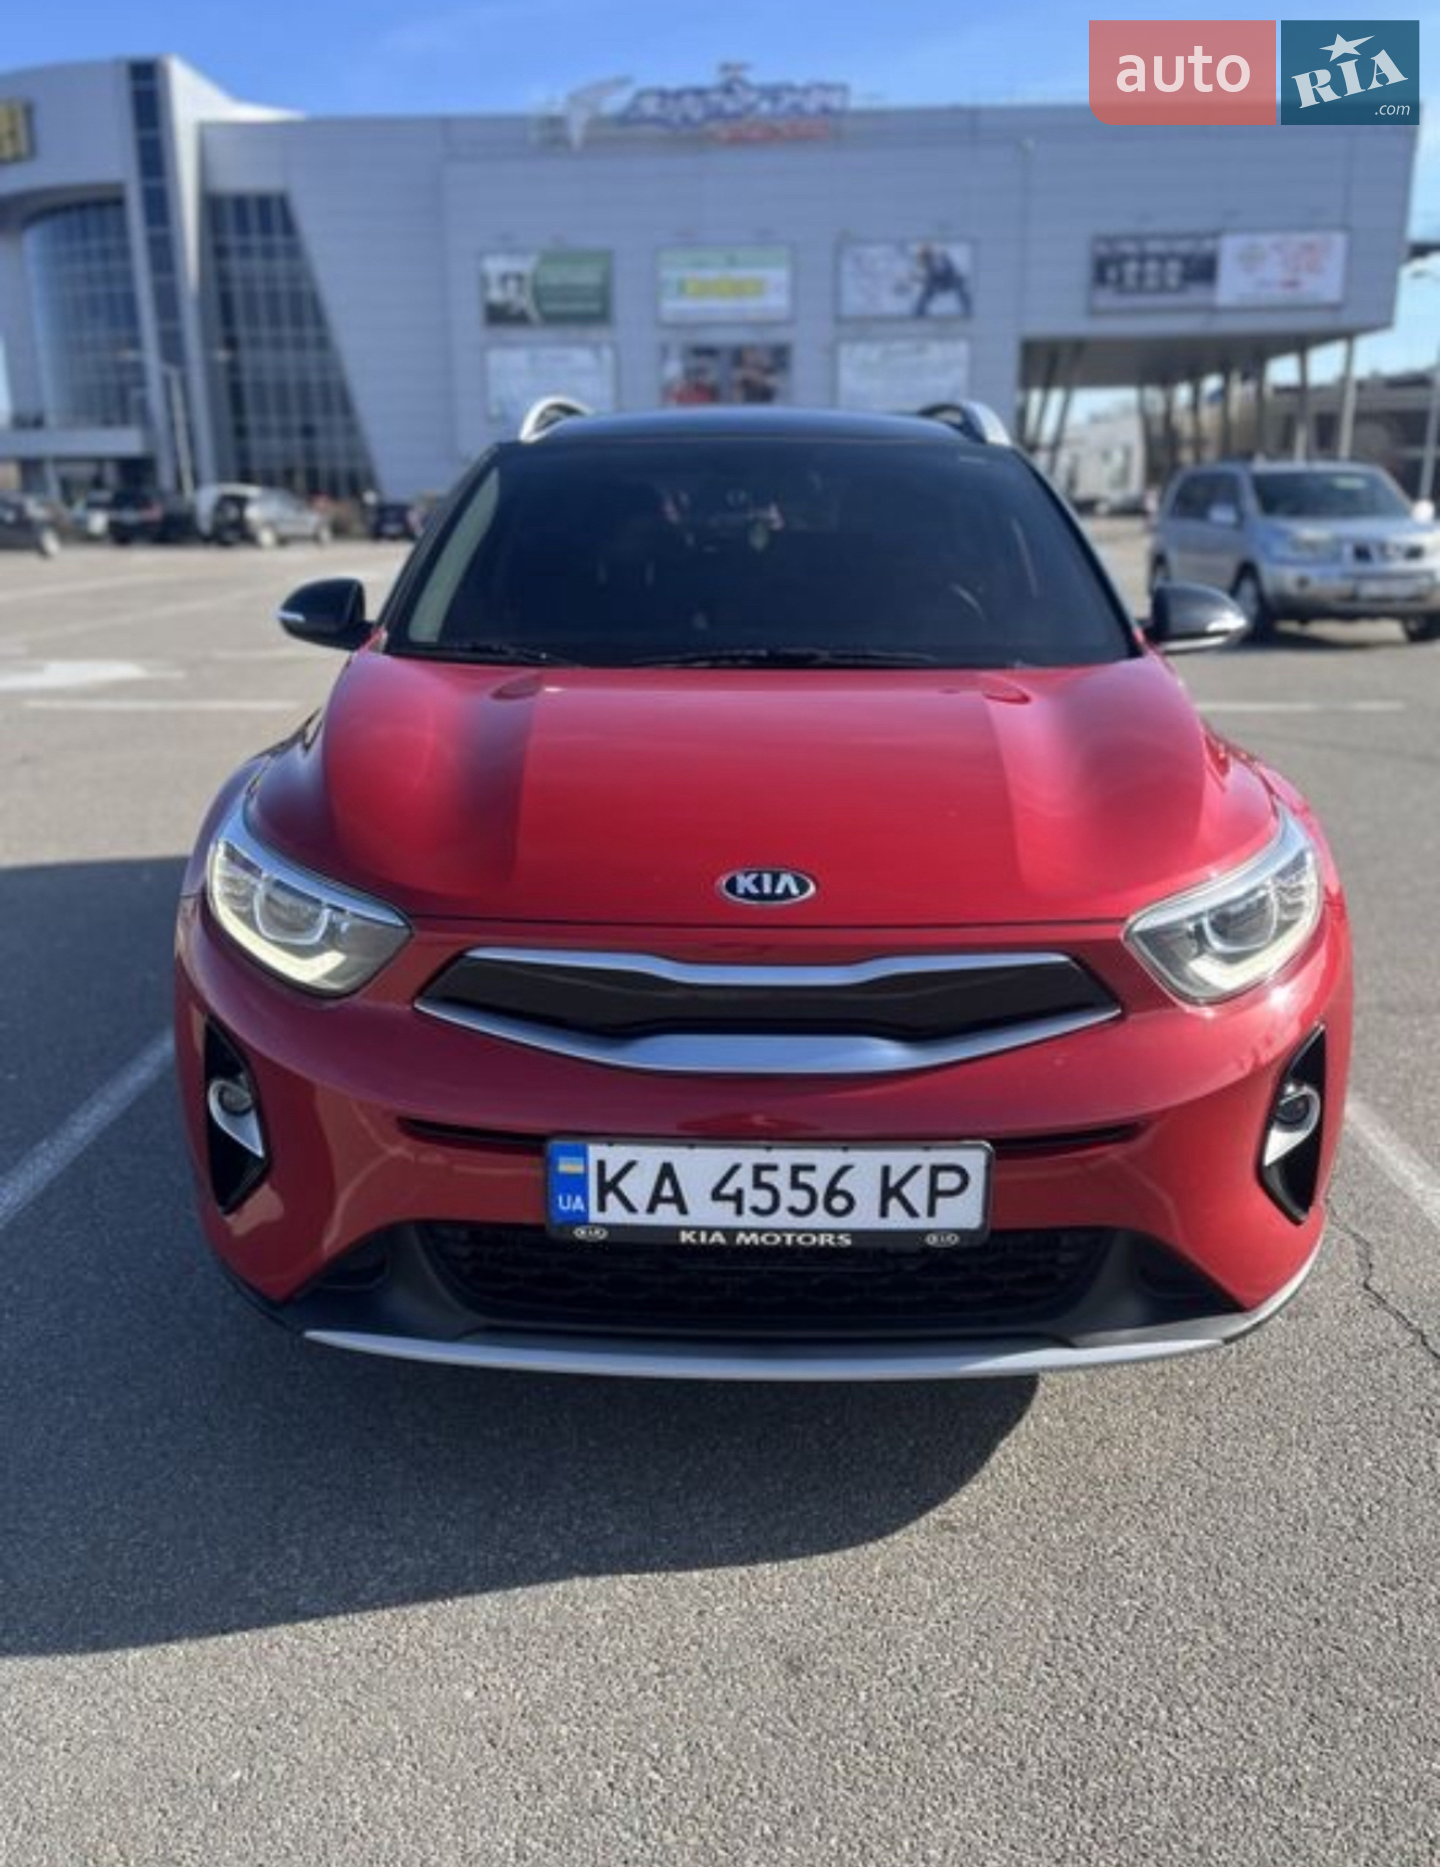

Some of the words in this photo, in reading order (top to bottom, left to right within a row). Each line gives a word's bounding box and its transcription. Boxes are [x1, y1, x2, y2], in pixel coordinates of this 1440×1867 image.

[735, 872, 800, 896] KIA
[597, 1159, 688, 1216] KA
[711, 1163, 857, 1218] 4556
[878, 1163, 971, 1219] KP
[558, 1194, 585, 1212] UA
[679, 1230, 729, 1245] KIA
[736, 1231, 852, 1247] MOTORS
